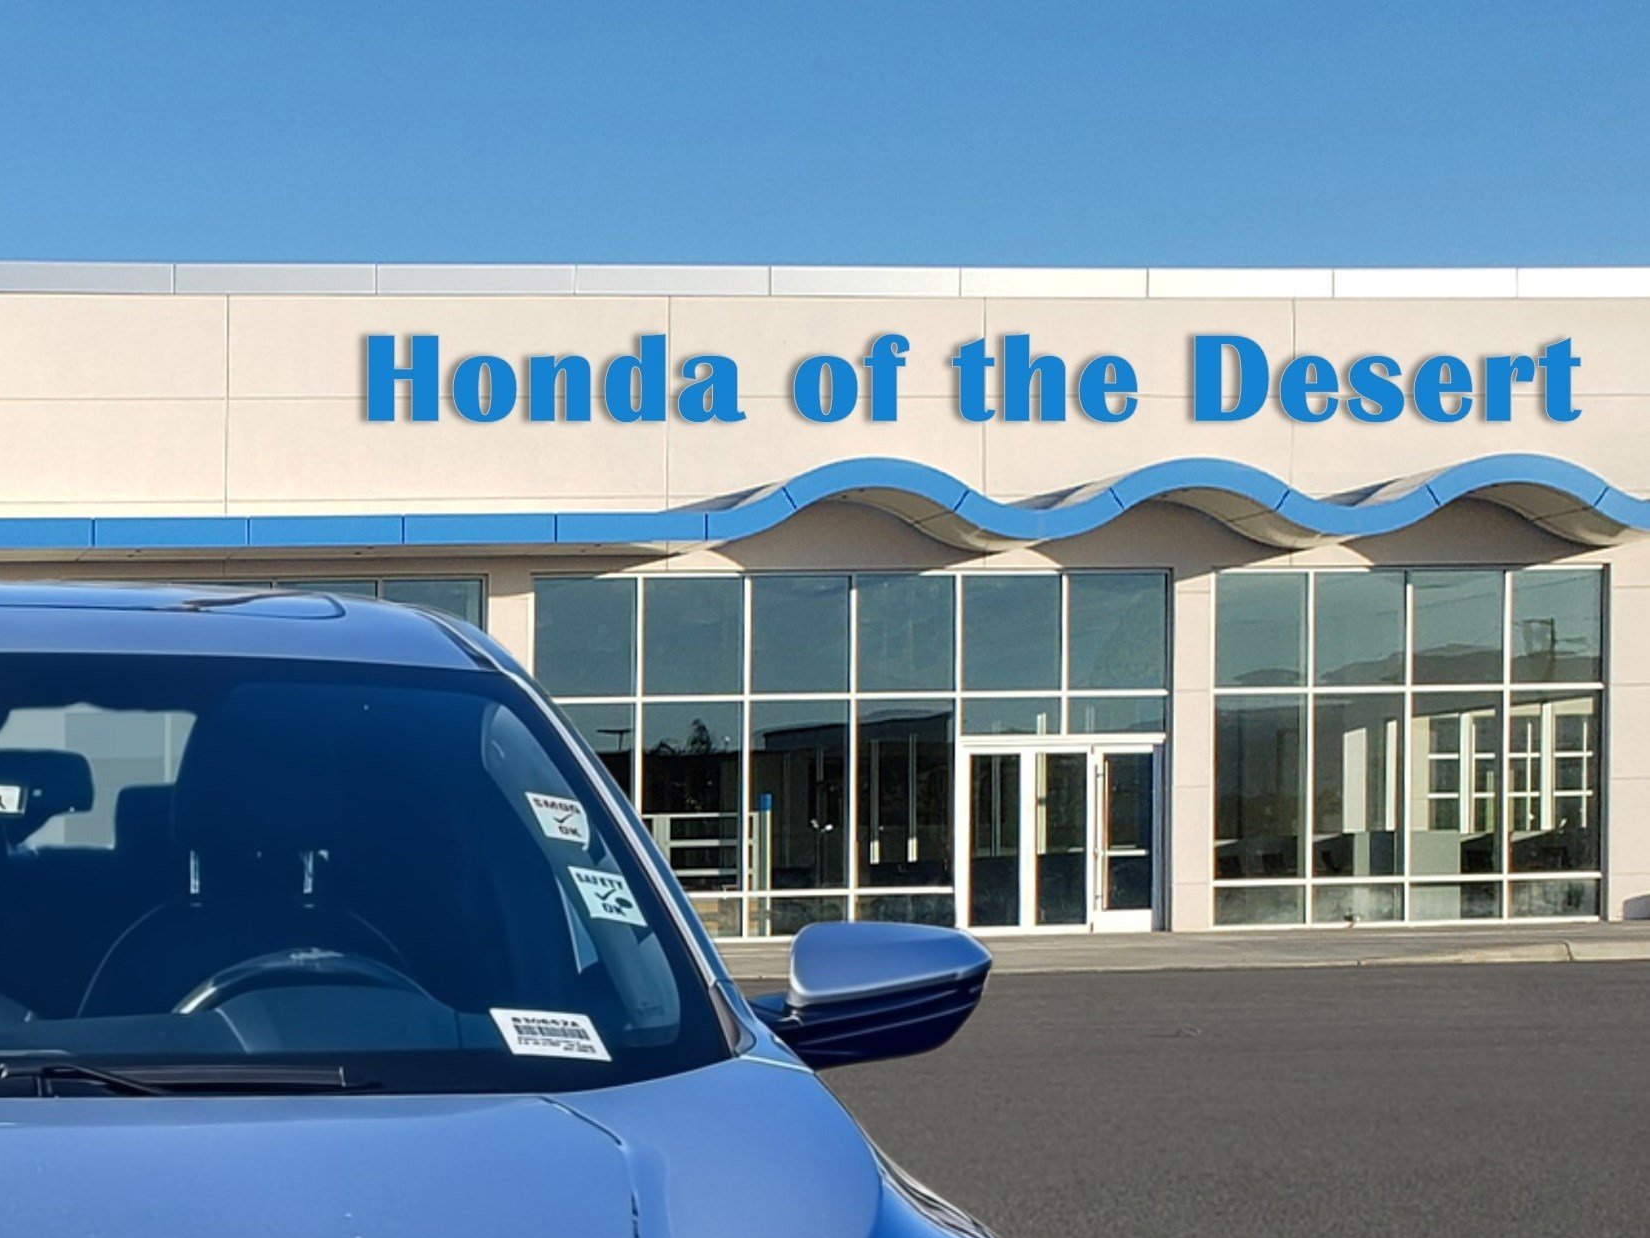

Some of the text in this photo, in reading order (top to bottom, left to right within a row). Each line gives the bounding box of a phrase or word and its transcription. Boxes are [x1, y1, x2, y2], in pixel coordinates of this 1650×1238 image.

[365, 332, 1583, 423] Honda of the Desert
[558, 825, 583, 838] OK
[575, 873, 624, 891] SAFETY
